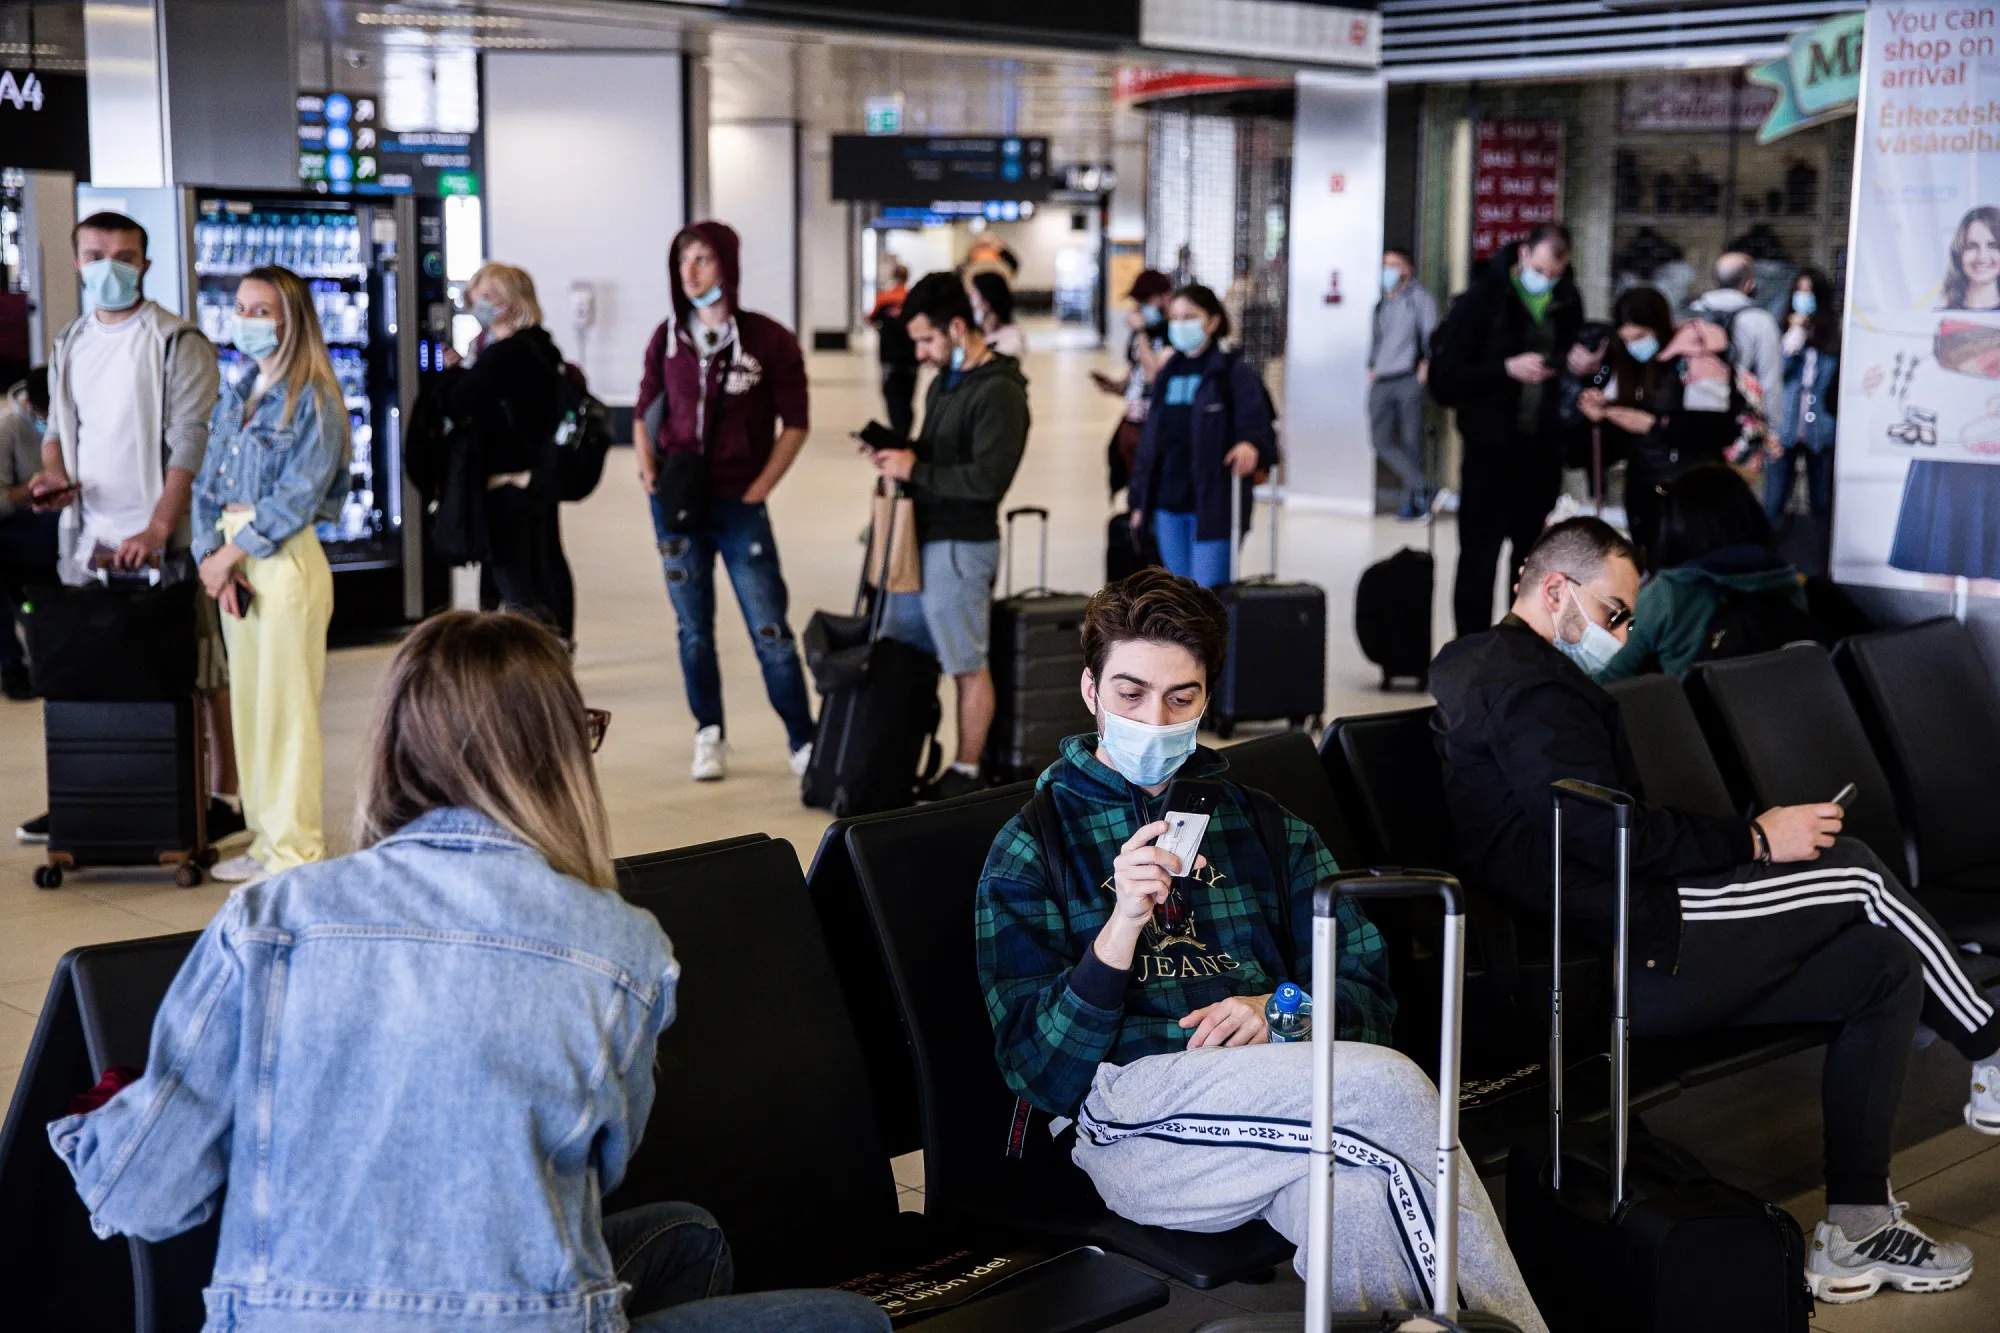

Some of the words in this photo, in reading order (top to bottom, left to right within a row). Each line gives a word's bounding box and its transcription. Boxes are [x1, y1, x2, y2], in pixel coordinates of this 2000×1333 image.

[1887, 7, 1937, 34] You
[1945, 7, 1995, 31] can
[1883, 37, 1951, 64] shop
[1959, 36, 1994, 57] on
[1882, 60, 1967, 89] arrival
[0, 70, 44, 111] A4
[1138, 952, 1240, 982] JEANS
[1189, 1124, 1230, 1136] JEANS
[1238, 1127, 1284, 1140] TOMMY
[1339, 1141, 1390, 1166] TOMMY
[1391, 1163, 1417, 1221] JEANS
[1853, 1226, 1938, 1267] NIKE
[962, 1257, 1012, 1278] ide!
